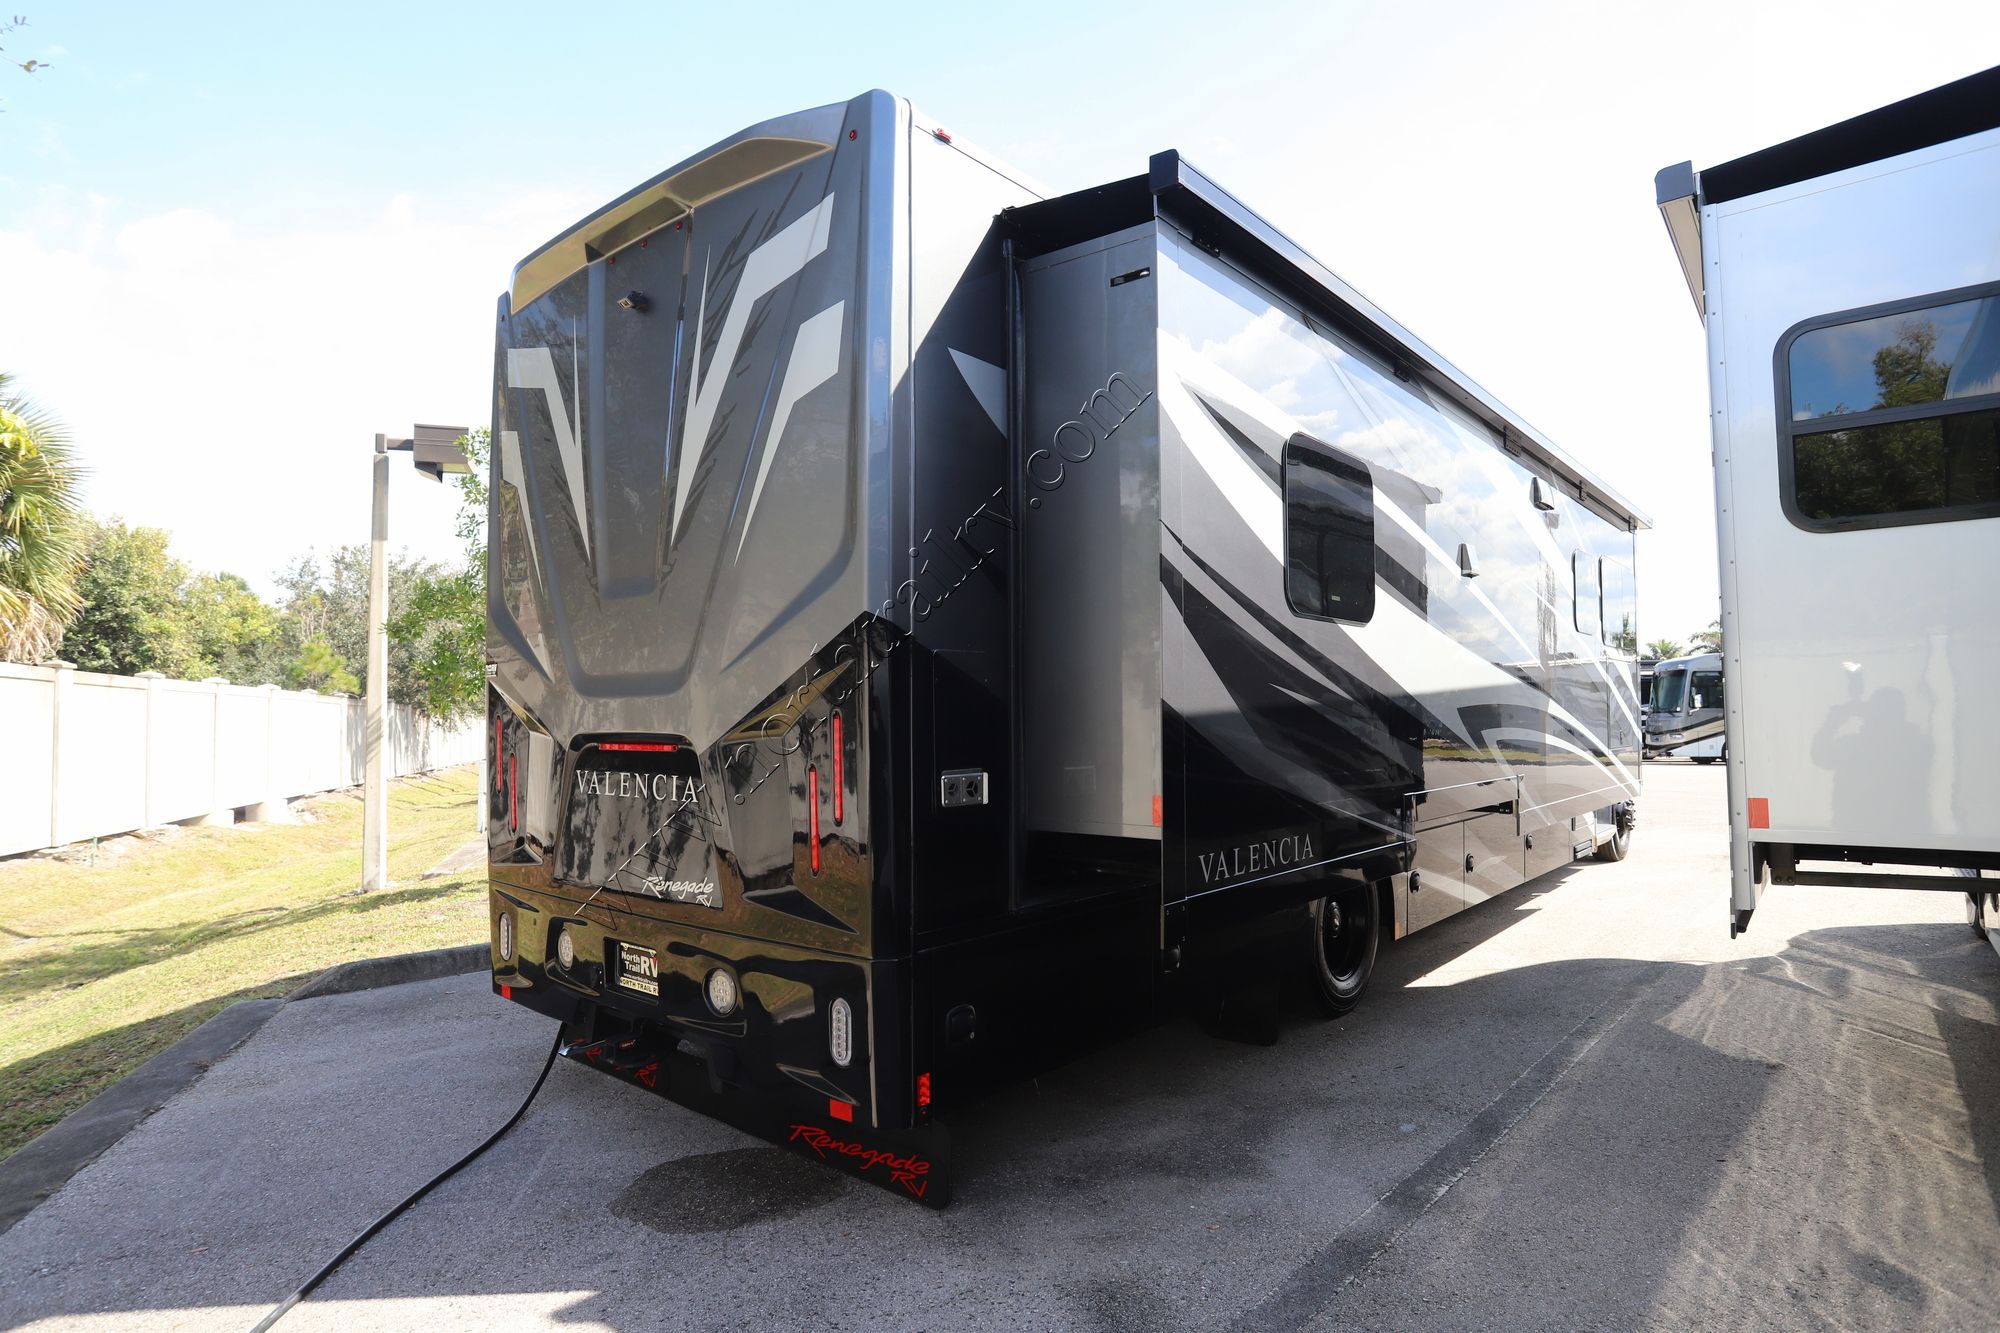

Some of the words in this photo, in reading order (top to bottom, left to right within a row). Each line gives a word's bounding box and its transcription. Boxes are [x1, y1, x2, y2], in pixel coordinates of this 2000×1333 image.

[575, 769, 699, 803] VALENCIA
[1198, 833, 1314, 883] VALENCIA
[641, 876, 714, 900] Renegade
[695, 894, 713, 908] RV
[621, 951, 640, 963] North
[624, 961, 640, 973] Trail
[640, 956, 658, 978] RV
[789, 1125, 931, 1175] Renegade
[891, 1171, 928, 1198] RV
